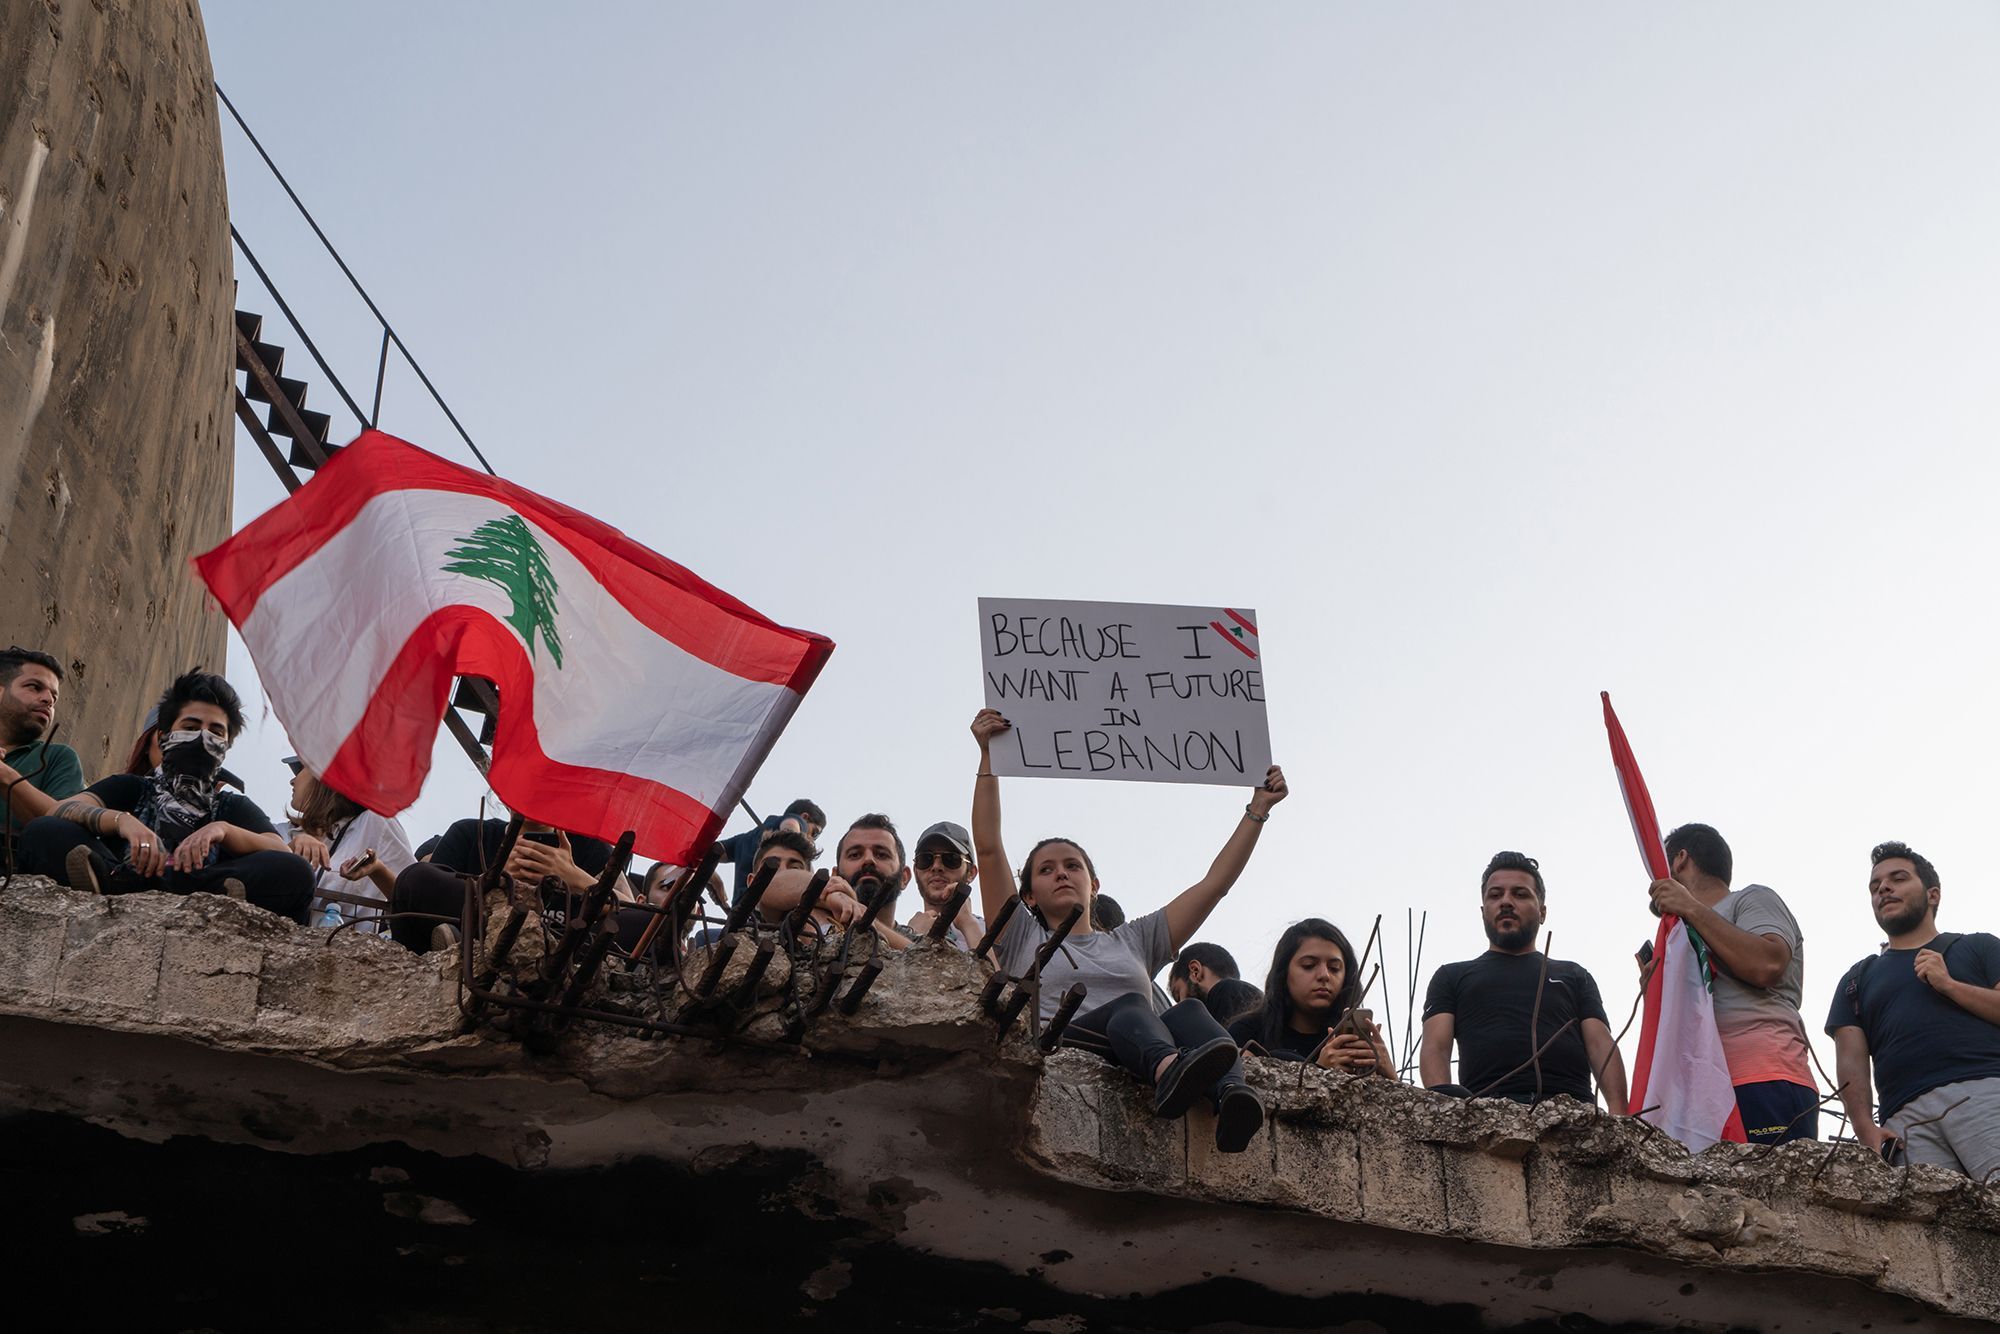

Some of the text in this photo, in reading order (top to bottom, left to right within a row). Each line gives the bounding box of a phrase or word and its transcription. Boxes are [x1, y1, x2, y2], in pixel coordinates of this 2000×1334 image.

[991, 613, 1212, 662] BECAUSE I
[988, 668, 1266, 702] WANT A FUTURE
[1100, 708, 1141, 726] IN
[1016, 727, 1245, 773] LEBANON
